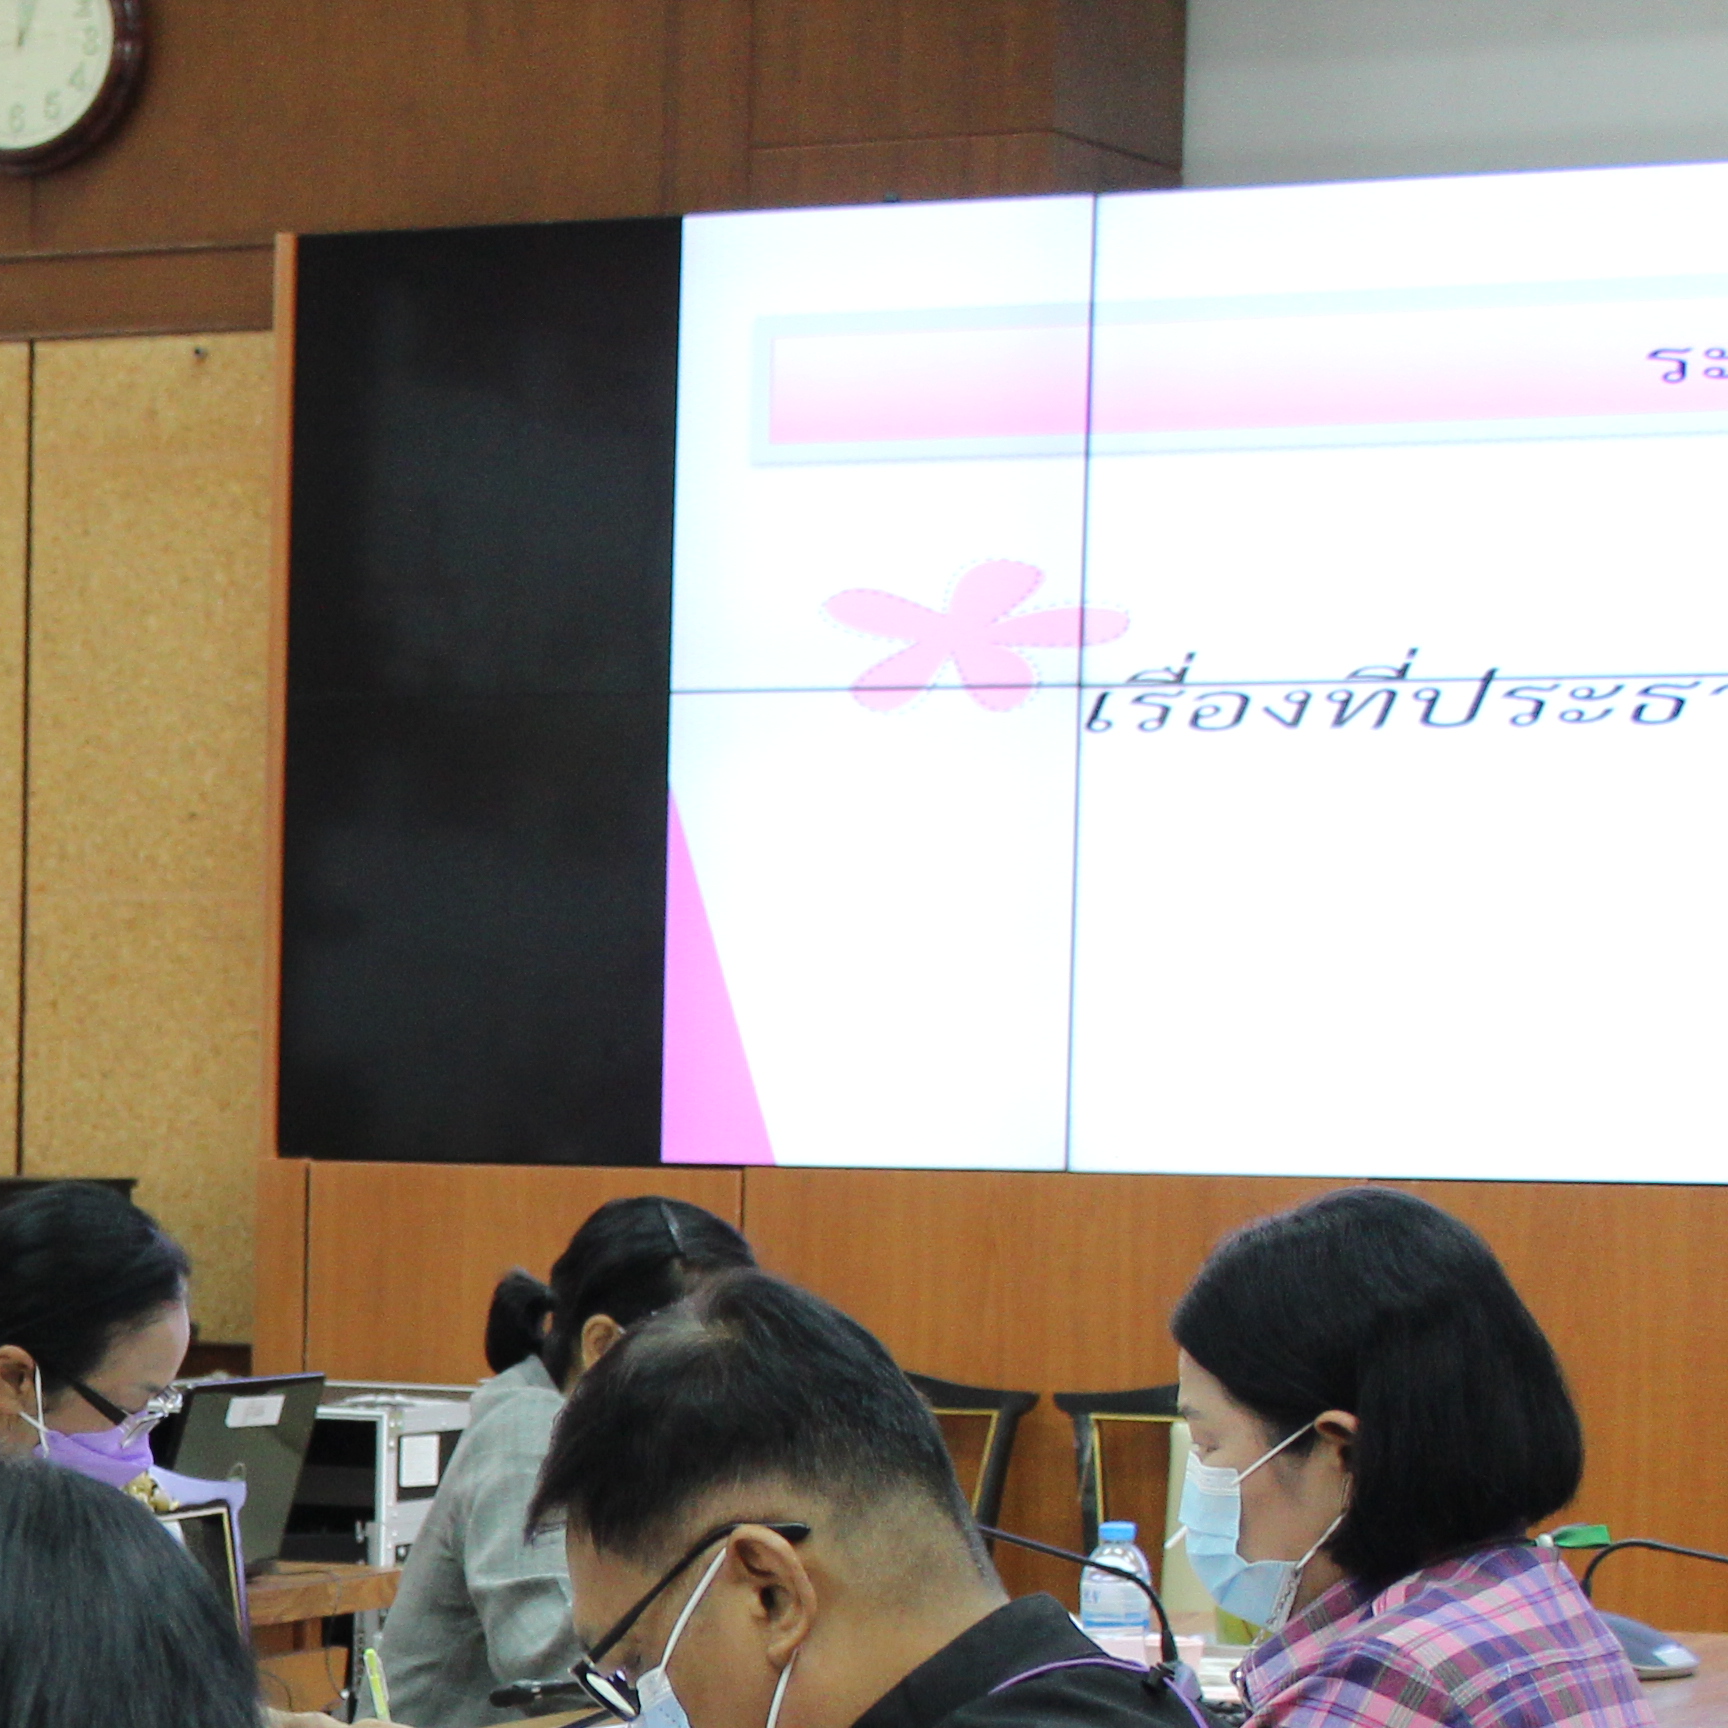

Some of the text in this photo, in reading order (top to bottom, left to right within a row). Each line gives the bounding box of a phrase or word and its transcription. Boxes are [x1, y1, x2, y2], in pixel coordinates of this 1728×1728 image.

[1084, 648, 1728, 732] เรื่องที่ประธ
